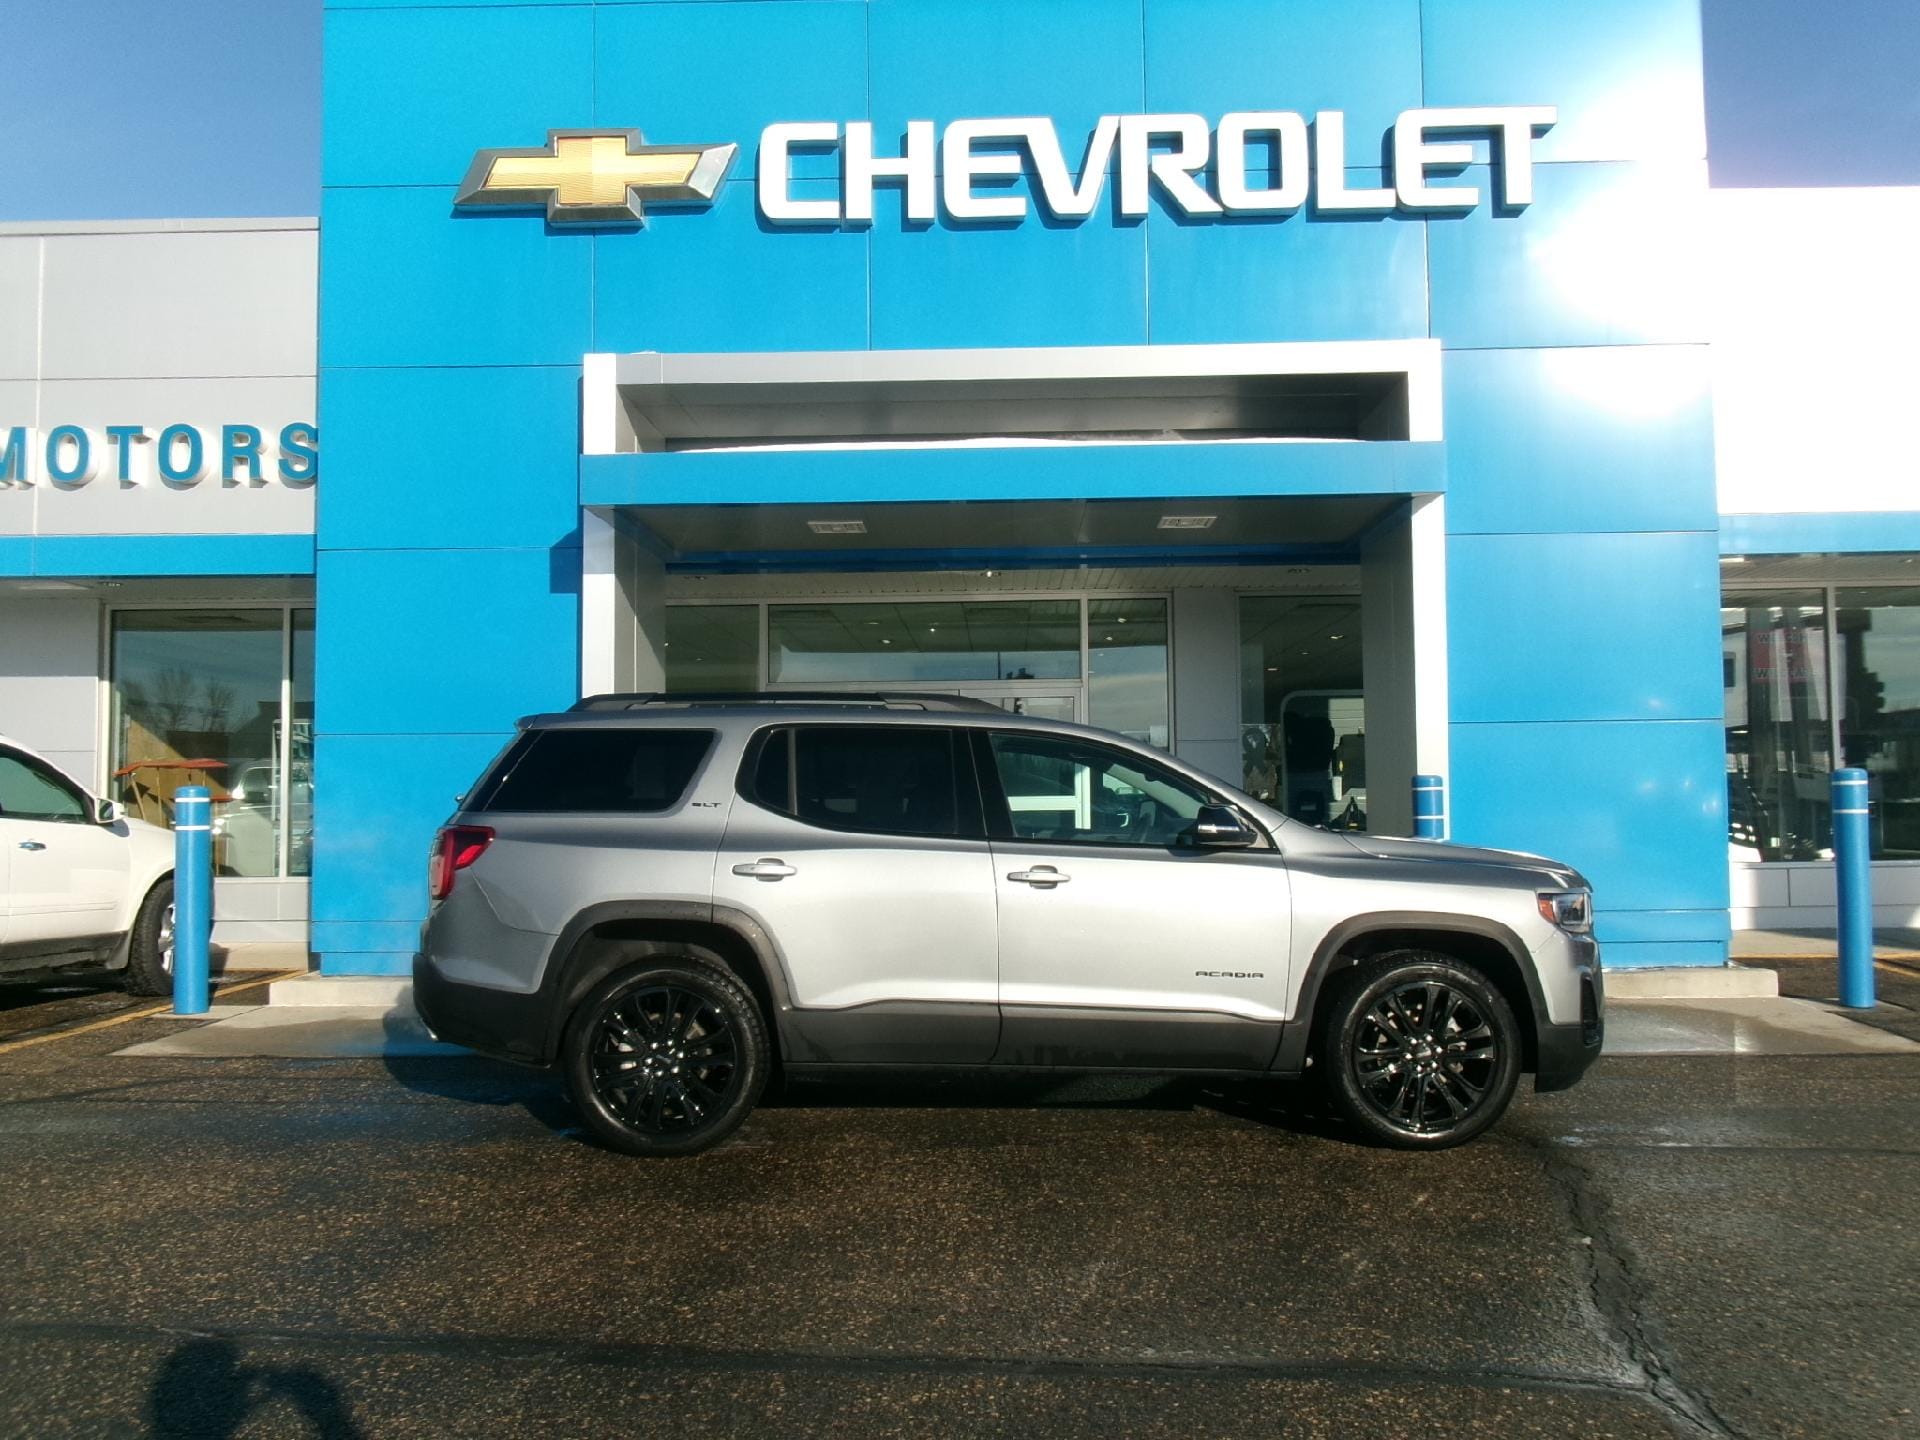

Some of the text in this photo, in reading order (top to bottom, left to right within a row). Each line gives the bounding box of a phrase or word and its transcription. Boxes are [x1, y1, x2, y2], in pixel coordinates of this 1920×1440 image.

[757, 105, 1558, 226] CHEVROLET
[0, 422, 319, 484] MOTORS
[1195, 970, 1265, 979] ACADIA
